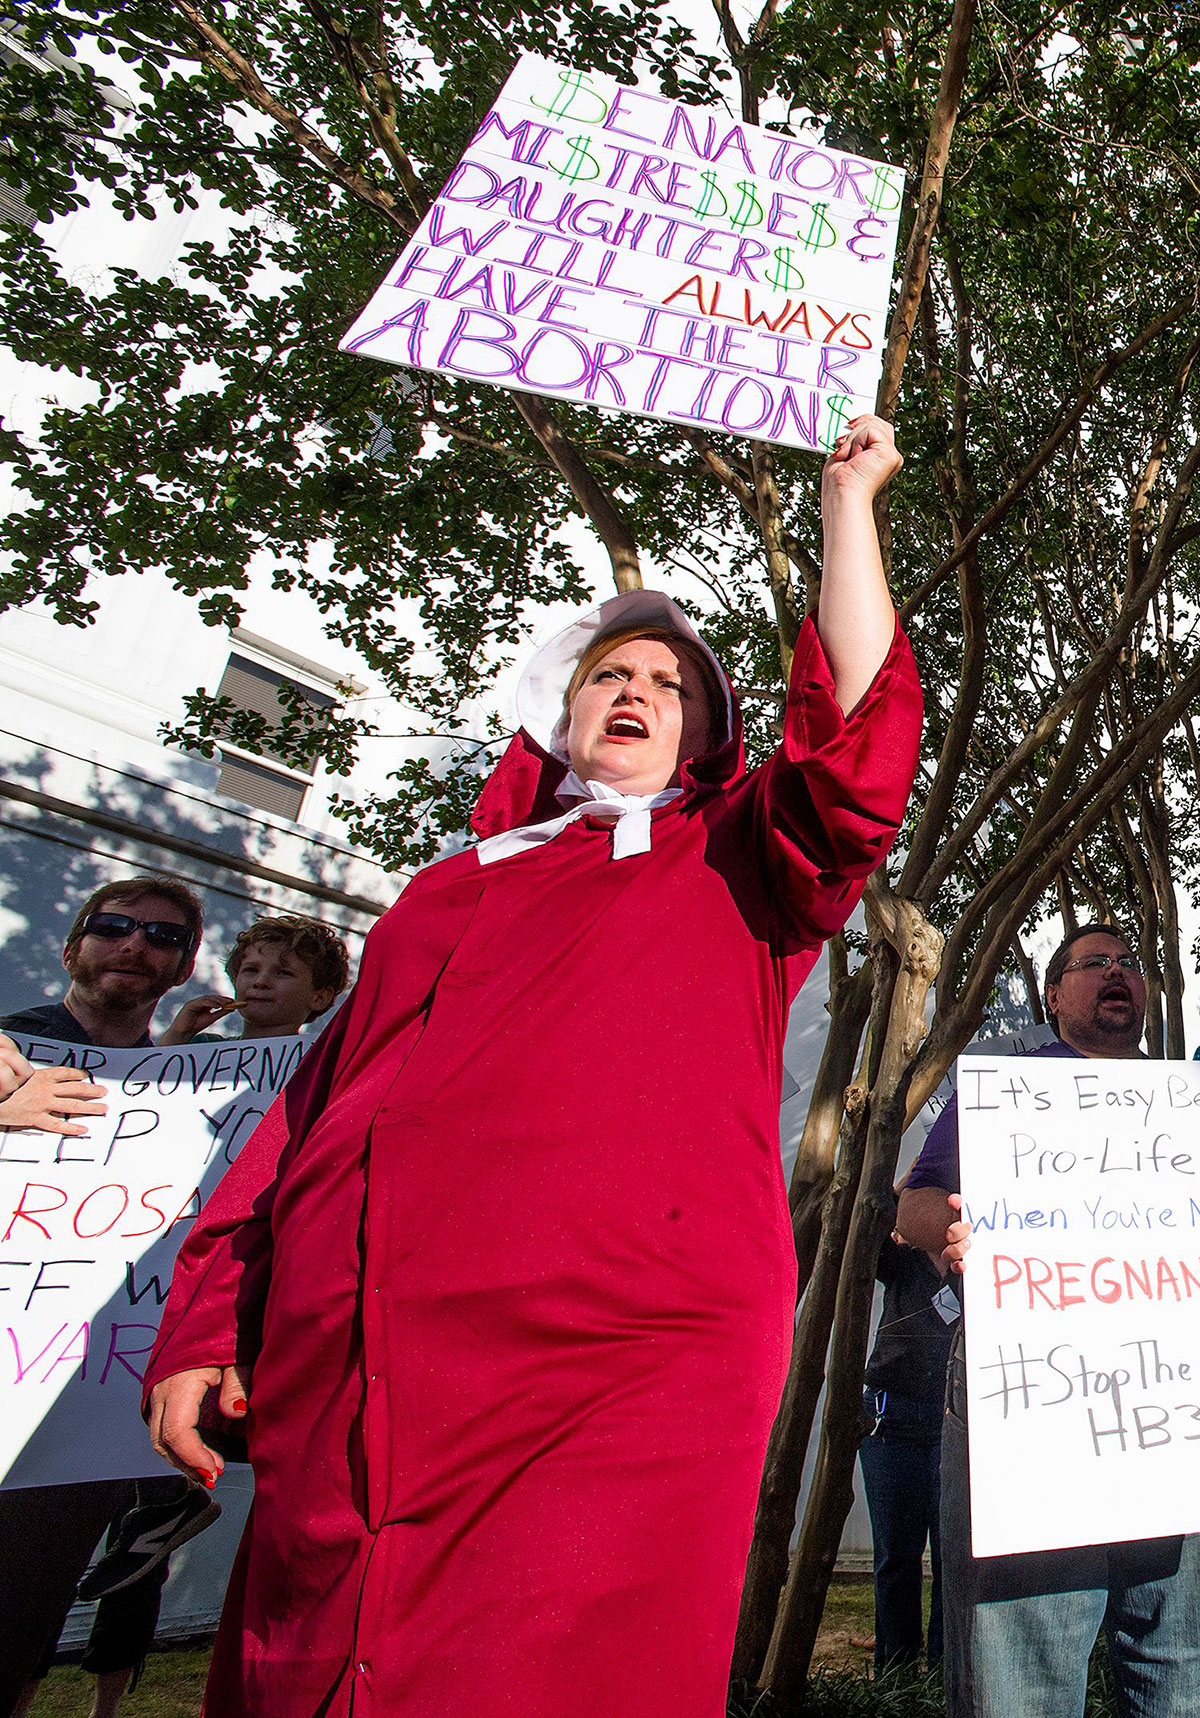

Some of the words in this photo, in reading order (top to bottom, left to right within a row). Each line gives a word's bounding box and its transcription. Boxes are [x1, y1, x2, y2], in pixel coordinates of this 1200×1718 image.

[428, 204, 644, 298] WILL
[661, 274, 874, 350] ALWAYS
[393, 246, 595, 333] HAVE
[623, 300, 860, 395] THEIR
[962, 1069, 1052, 1111] It's
[1073, 1075, 1155, 1127] Easy
[1010, 1133, 1196, 1178] Pro-Life
[966, 1198, 1068, 1233] When
[1084, 1196, 1177, 1230] You're
